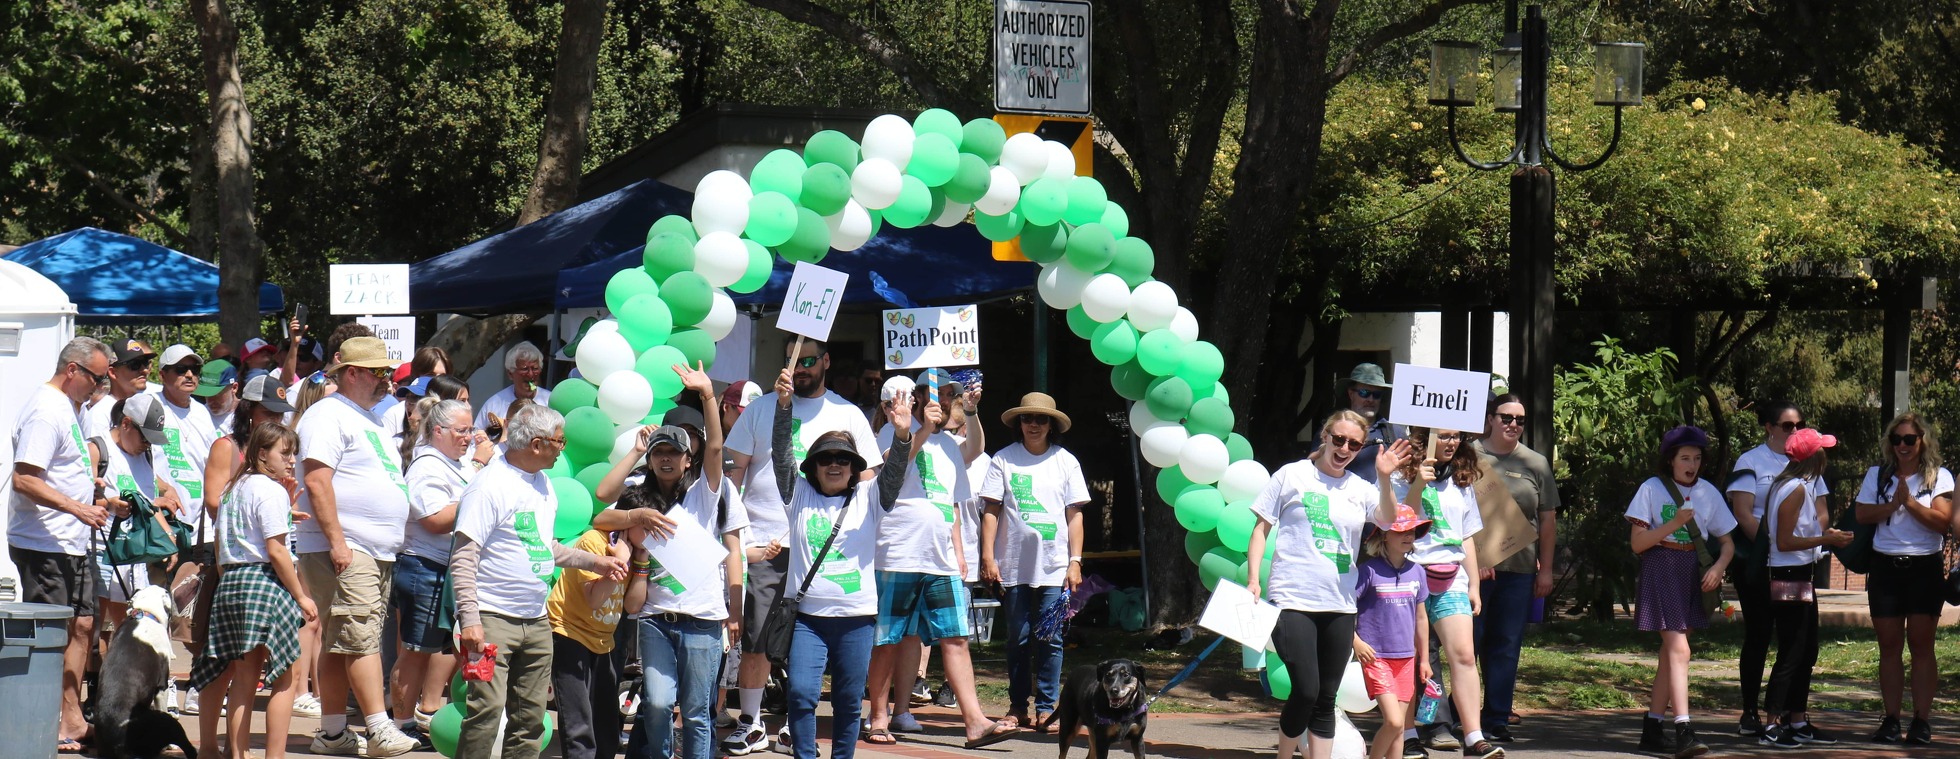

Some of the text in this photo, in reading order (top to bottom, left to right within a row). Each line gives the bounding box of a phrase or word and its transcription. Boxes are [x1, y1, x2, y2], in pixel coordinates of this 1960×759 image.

[1002, 11, 1085, 38] AUTHORIZED
[1012, 43, 1075, 69] VEHICLES
[1027, 75, 1060, 99] ONLY
[345, 272, 391, 286] TEAM
[343, 290, 398, 305] ZACK
[371, 324, 400, 340] Team
[886, 326, 977, 349] PathPoint
[1410, 384, 1469, 411] Emeli
